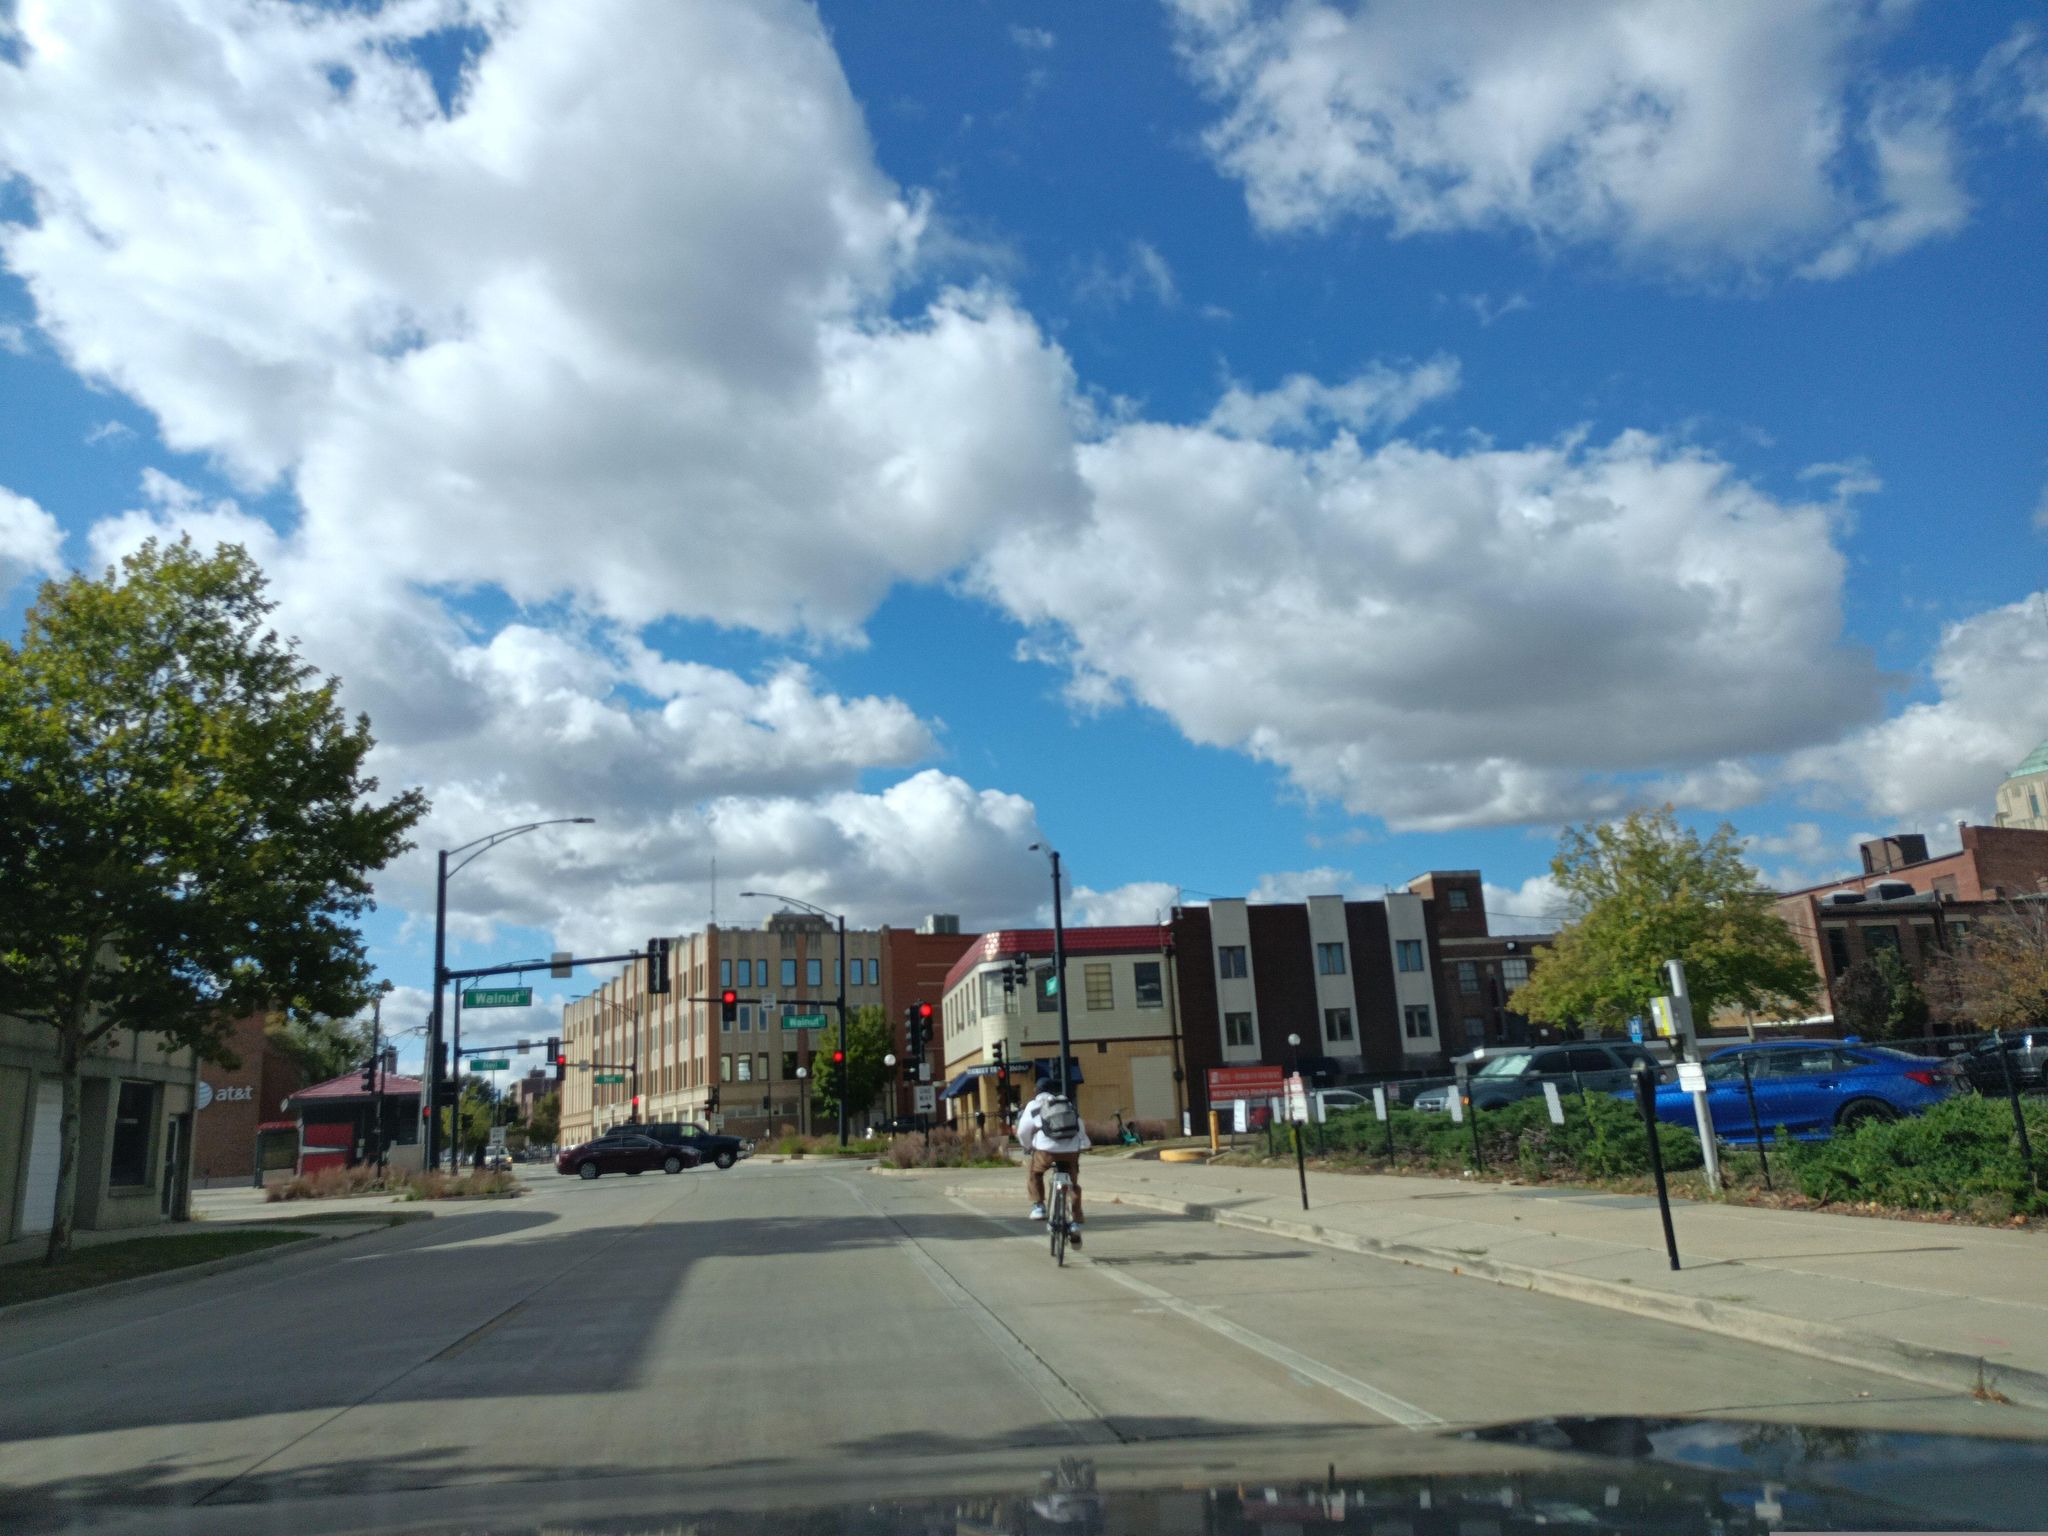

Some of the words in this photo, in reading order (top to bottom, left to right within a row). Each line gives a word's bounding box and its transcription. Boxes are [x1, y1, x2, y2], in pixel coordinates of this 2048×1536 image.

[475, 991, 520, 1004] Walnut
[789, 1017, 819, 1028] Walnut
[215, 1086, 253, 1101] at&t
